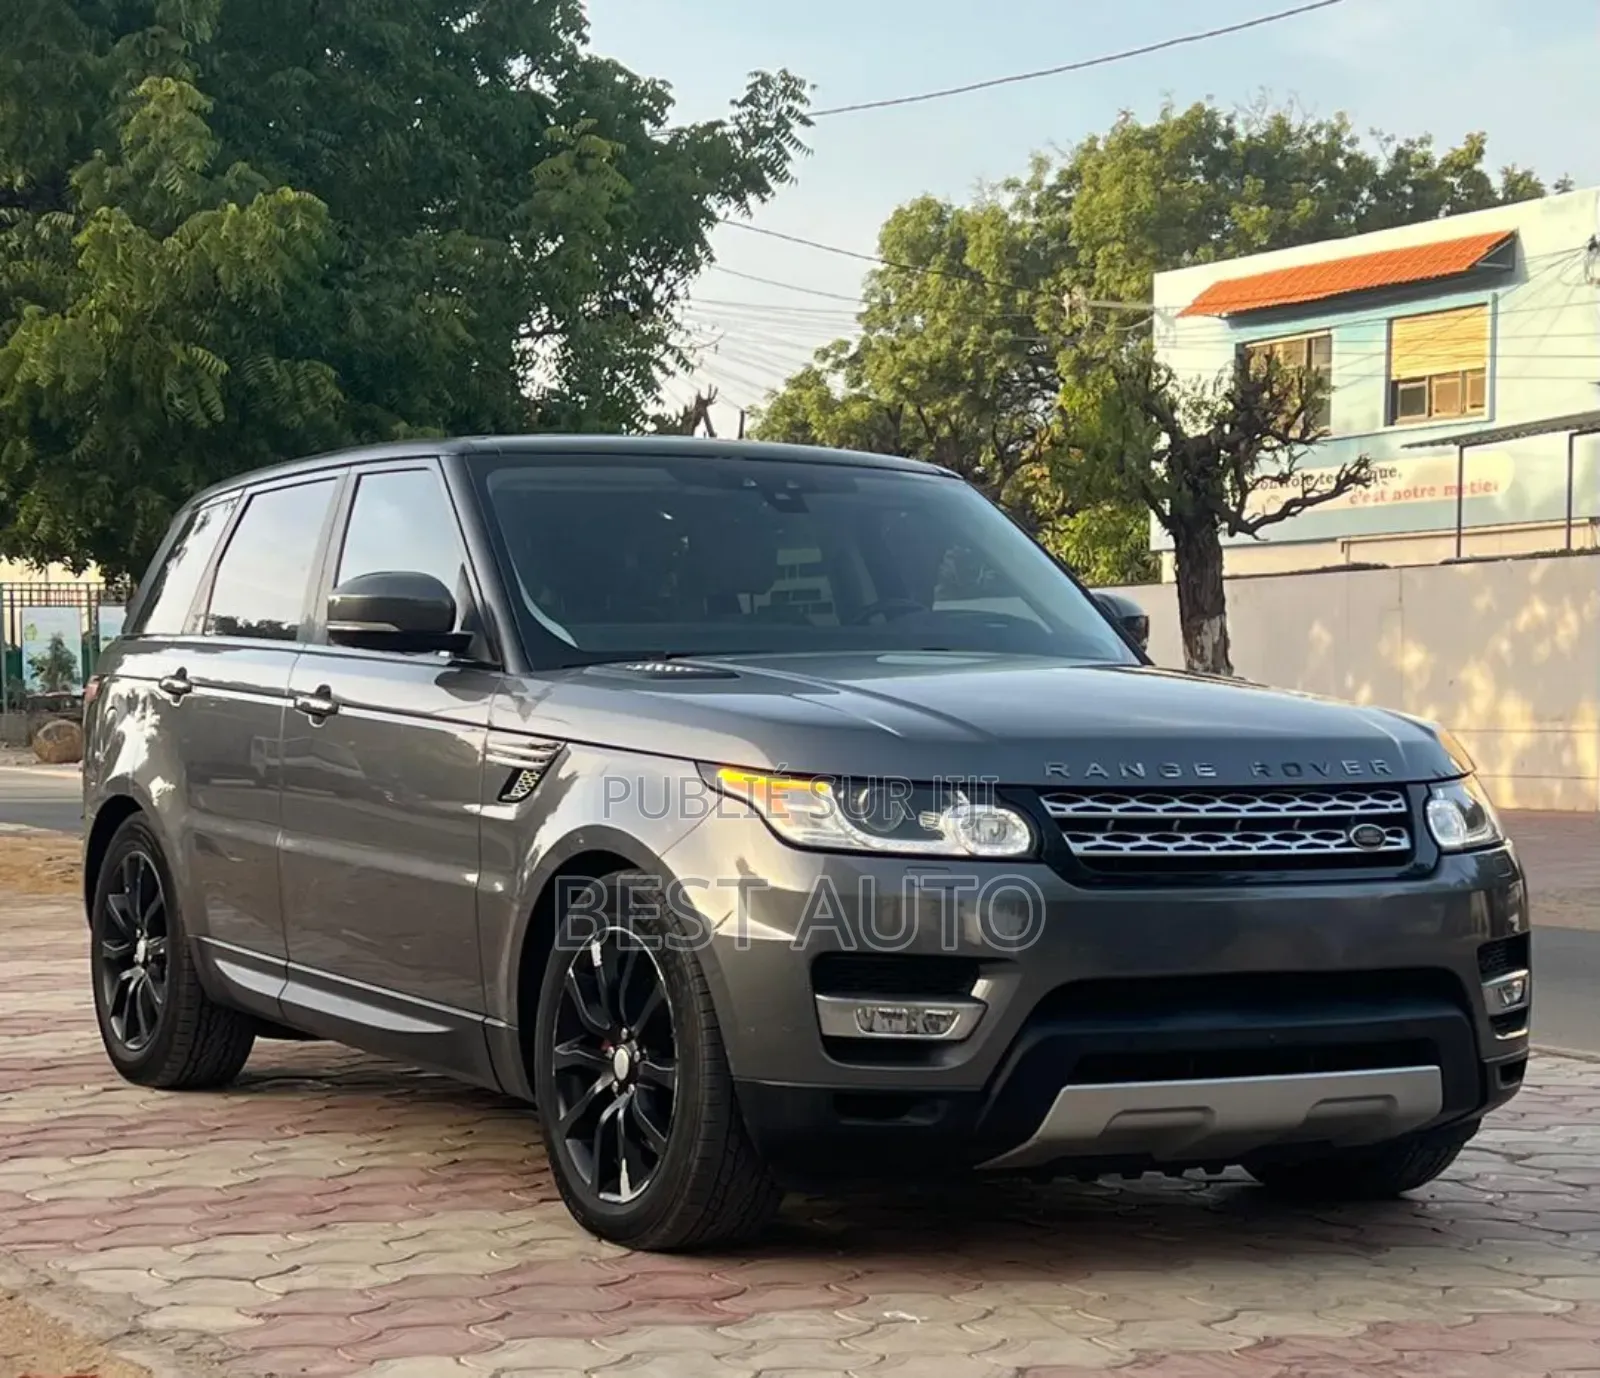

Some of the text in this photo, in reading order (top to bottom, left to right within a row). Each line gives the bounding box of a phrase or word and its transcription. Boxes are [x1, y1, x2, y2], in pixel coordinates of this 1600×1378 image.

[1349, 487, 1386, 505] c'est
[1393, 484, 1436, 501] notre
[1044, 759, 1392, 779] RANGE ROVER
